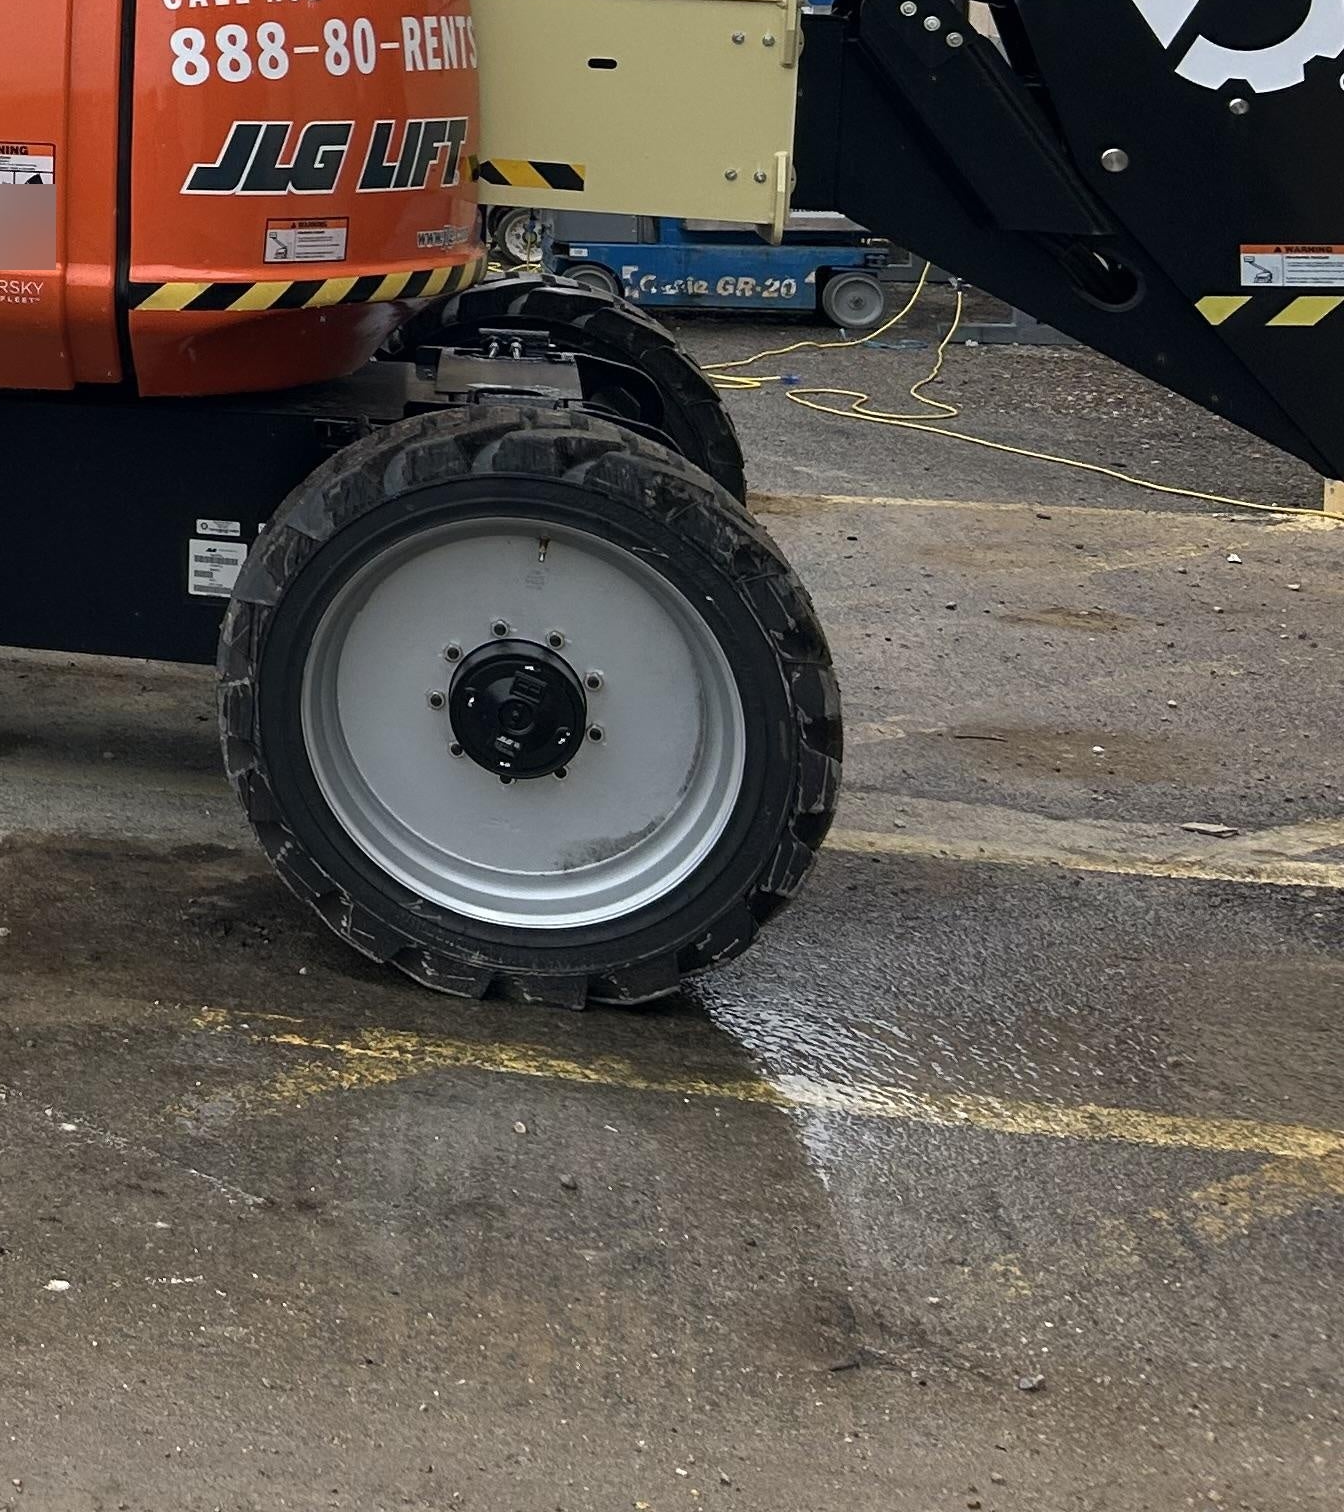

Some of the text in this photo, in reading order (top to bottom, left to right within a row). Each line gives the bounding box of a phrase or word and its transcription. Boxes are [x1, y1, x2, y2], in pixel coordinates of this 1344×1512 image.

[180, 117, 469, 195] JLG LIFT
[1286, 246, 1334, 254] WARNING
[716, 275, 798, 299] GR-20
